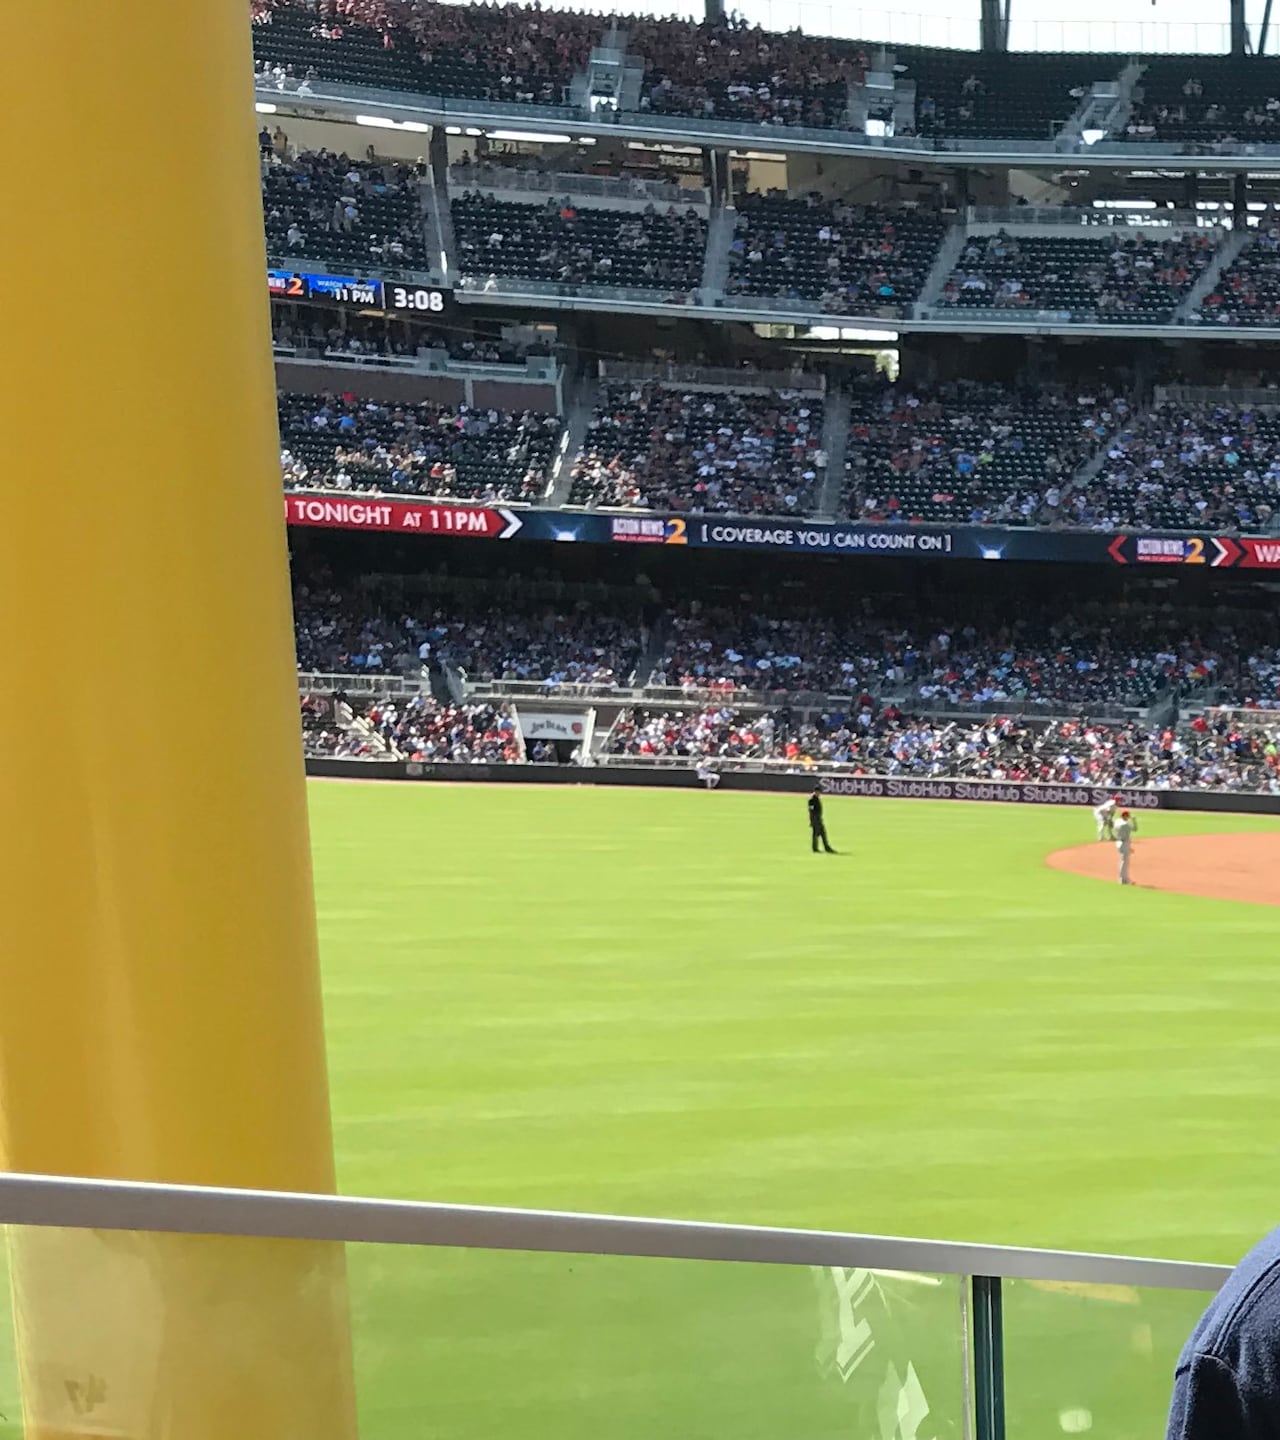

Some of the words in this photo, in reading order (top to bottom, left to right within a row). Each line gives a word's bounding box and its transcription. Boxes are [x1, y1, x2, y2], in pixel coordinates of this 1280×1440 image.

[287, 278, 304, 296] 2
[335, 288, 348, 301] 11
[352, 290, 375, 304] PM
[393, 288, 444, 312] 3:08
[294, 500, 392, 525] TONIGHT
[402, 512, 422, 527] AT
[429, 510, 488, 532] 11PM
[665, 518, 688, 544] 2
[711, 526, 794, 545] COVERAGE
[796, 530, 830, 547] YOU
[833, 532, 865, 548] CAN
[867, 533, 916, 549] COUNT
[918, 535, 942, 550] ON
[1184, 537, 1206, 563] 2
[820, 778, 883, 794] StubHub
[886, 781, 952, 798] StubHub
[955, 783, 1020, 801] StubHub
[1022, 787, 1089, 803] StubHub
